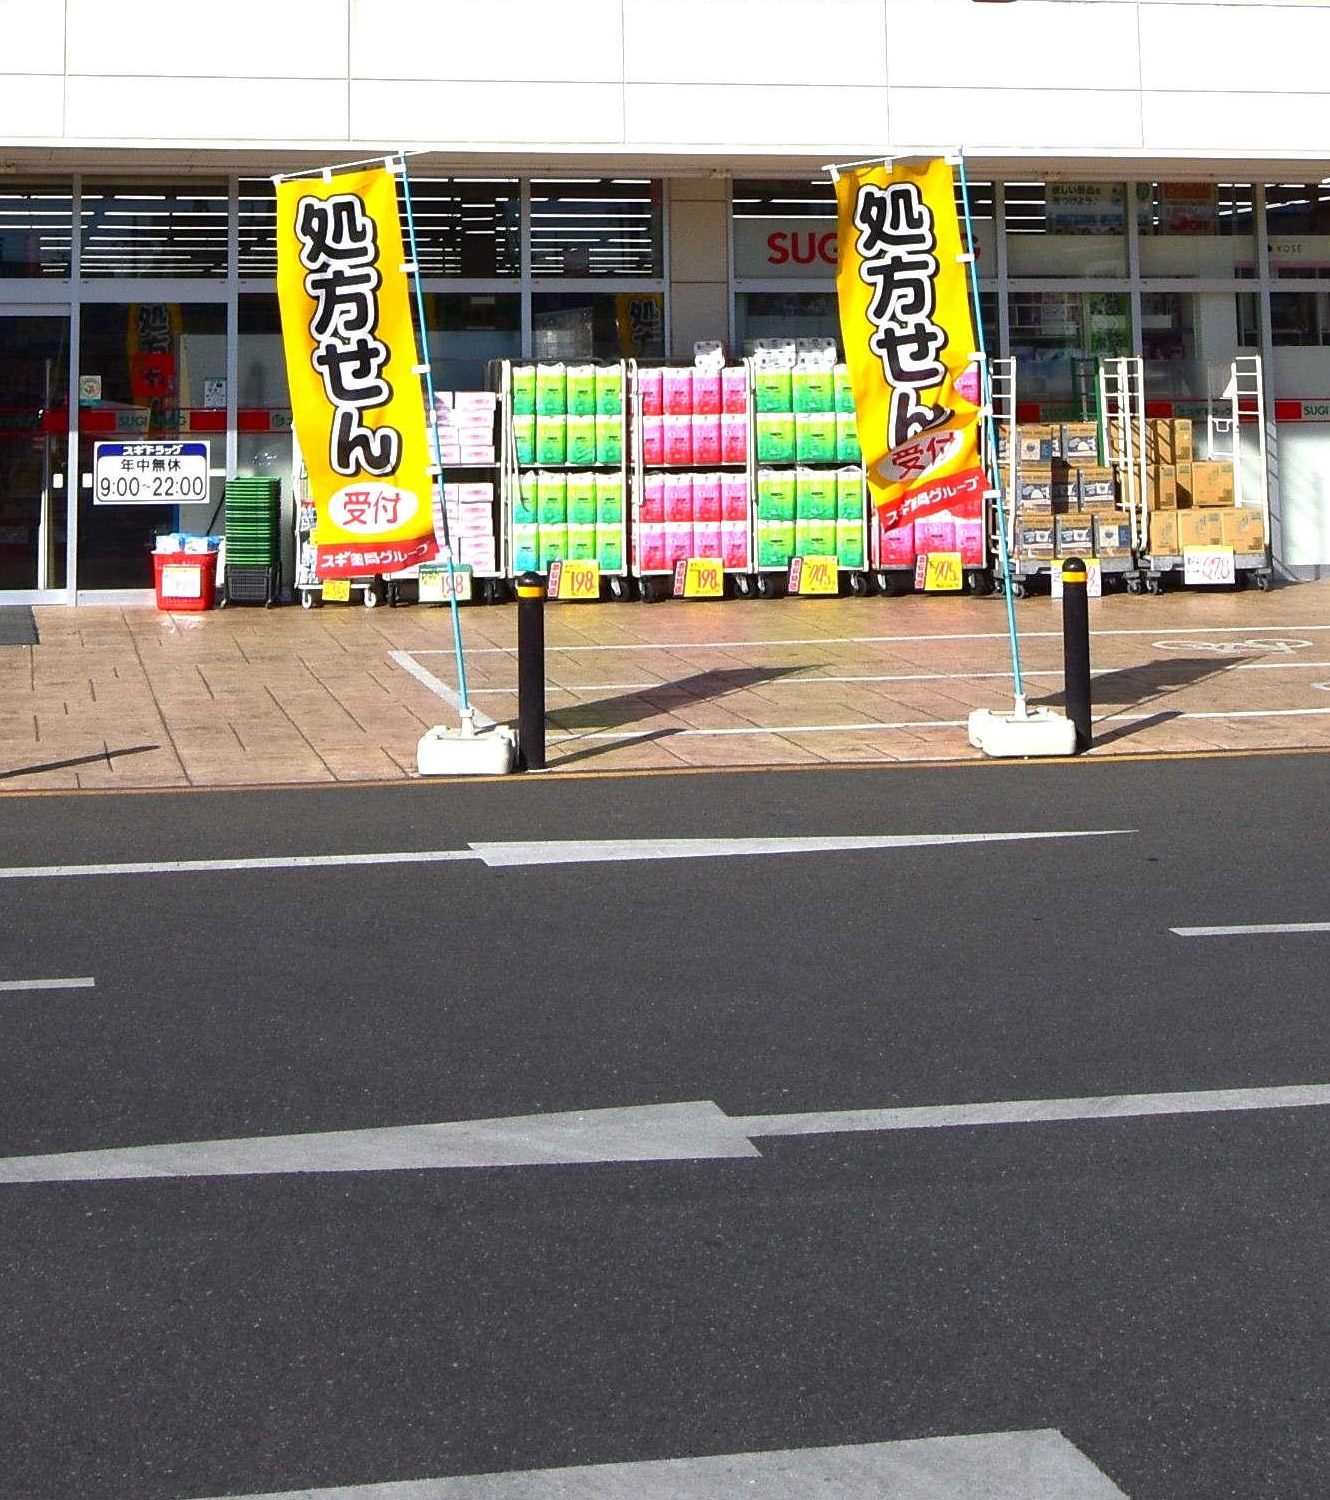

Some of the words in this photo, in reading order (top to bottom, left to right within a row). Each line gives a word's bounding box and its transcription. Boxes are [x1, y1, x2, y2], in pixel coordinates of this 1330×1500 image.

[767, 232, 838, 265] SUG
[853, 182, 955, 452] 処方せん
[295, 196, 401, 476] 処方せん
[1303, 405, 1329, 416] SUGI
[122, 443, 184, 456] スギドラッグ
[892, 430, 956, 480] 受付
[120, 458, 182, 473] 年中無休
[342, 490, 402, 526] 受付
[924, 524, 951, 536] Oasis
[321, 541, 430, 568] スギ薬局グループ
[570, 570, 594, 592] 198
[696, 568, 719, 590] 198
